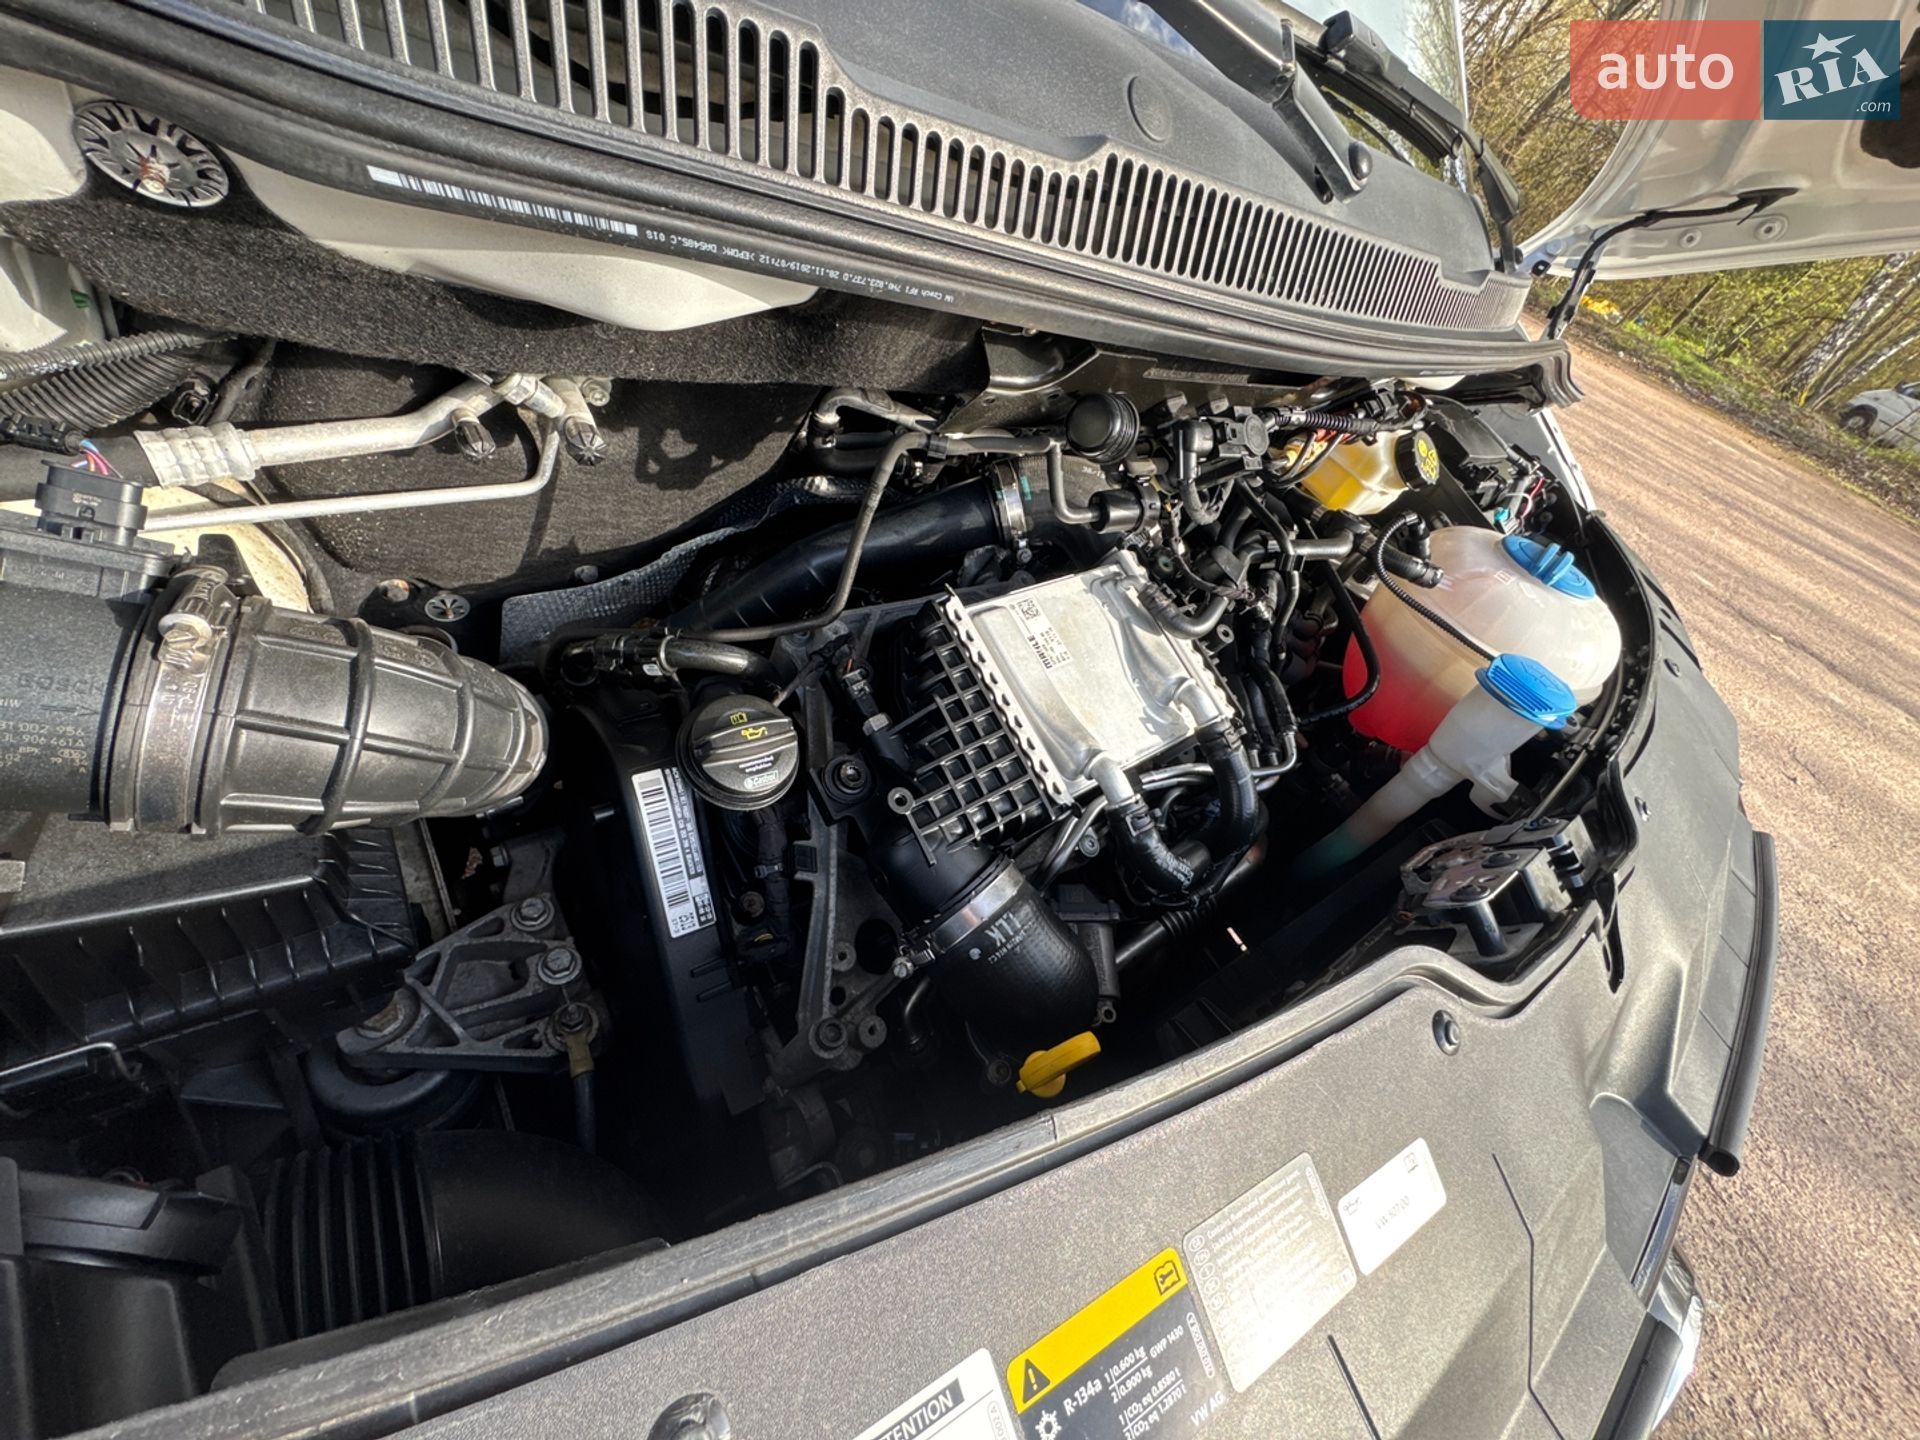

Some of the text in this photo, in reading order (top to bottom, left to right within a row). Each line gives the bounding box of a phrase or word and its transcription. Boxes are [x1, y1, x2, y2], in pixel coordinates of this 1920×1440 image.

[1150, 1325, 1184, 1358] GWP 1430
[1063, 1379, 1102, 1416] R-134a
[1133, 1346, 1146, 1359] kg
[1140, 1365, 1153, 1379] kg
[1190, 1390, 1227, 1427] VW AG
